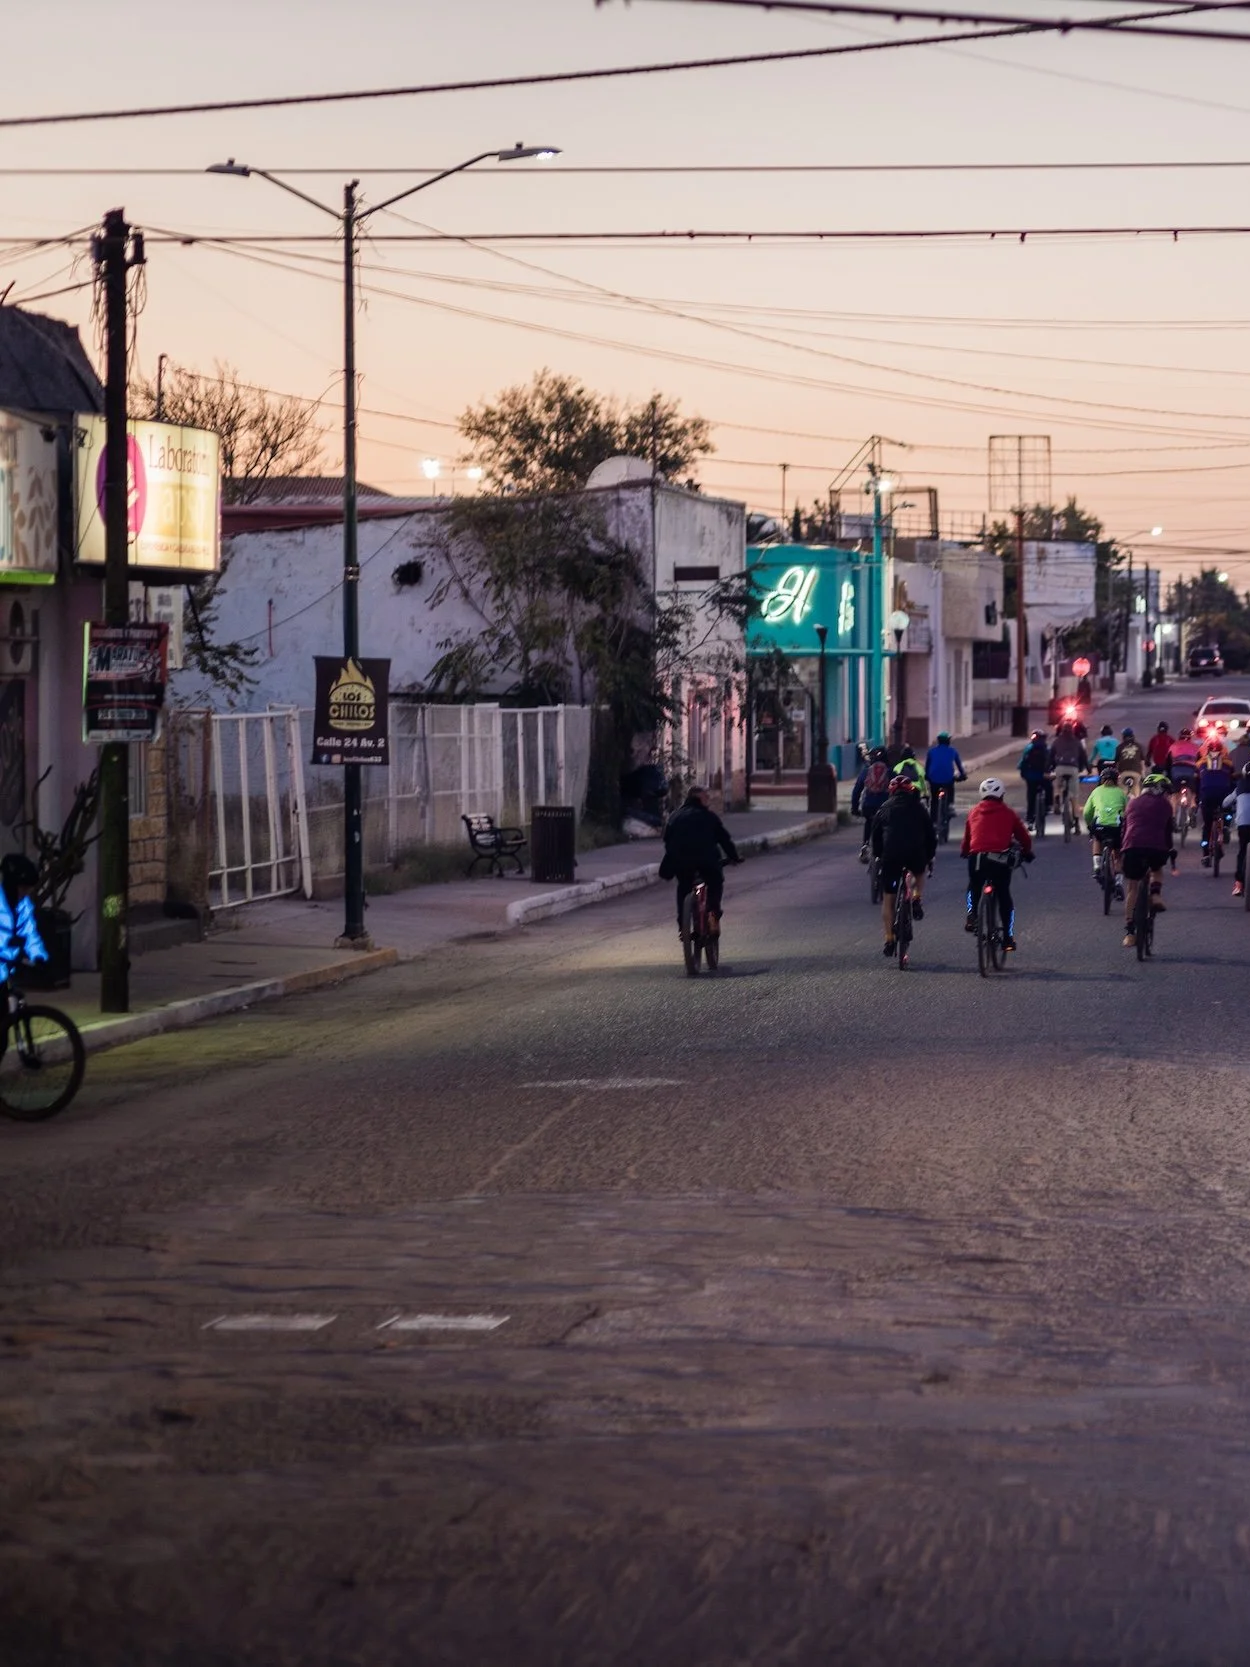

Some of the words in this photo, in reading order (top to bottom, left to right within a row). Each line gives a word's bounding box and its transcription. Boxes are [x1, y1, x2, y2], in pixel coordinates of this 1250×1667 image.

[343, 692, 361, 701] LOS
[329, 704, 375, 719] CHILOS
[316, 736, 342, 747] Calle
[344, 737, 357, 748] 24
[360, 738, 375, 748] Av.
[377, 738, 385, 748] 2
